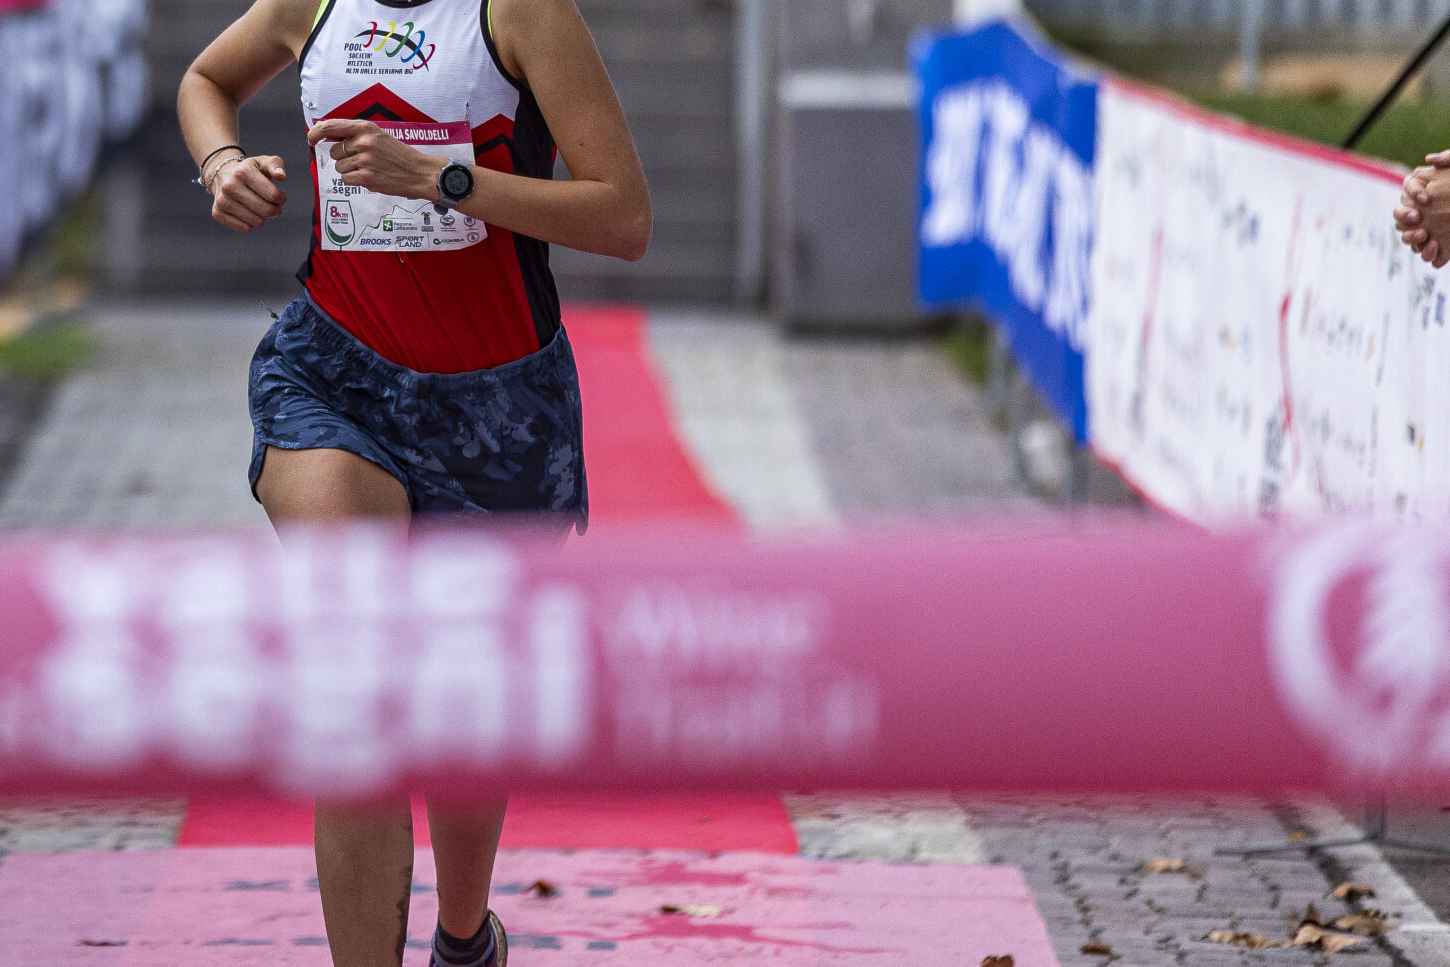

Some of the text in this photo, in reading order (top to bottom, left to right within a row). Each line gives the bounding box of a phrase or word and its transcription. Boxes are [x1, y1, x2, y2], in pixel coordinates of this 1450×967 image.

[344, 43, 362, 51] POOL
[380, 127, 450, 141] ULIA SAVOLDELLI
[333, 186, 361, 197] segni
[360, 238, 392, 246] BROOKS
